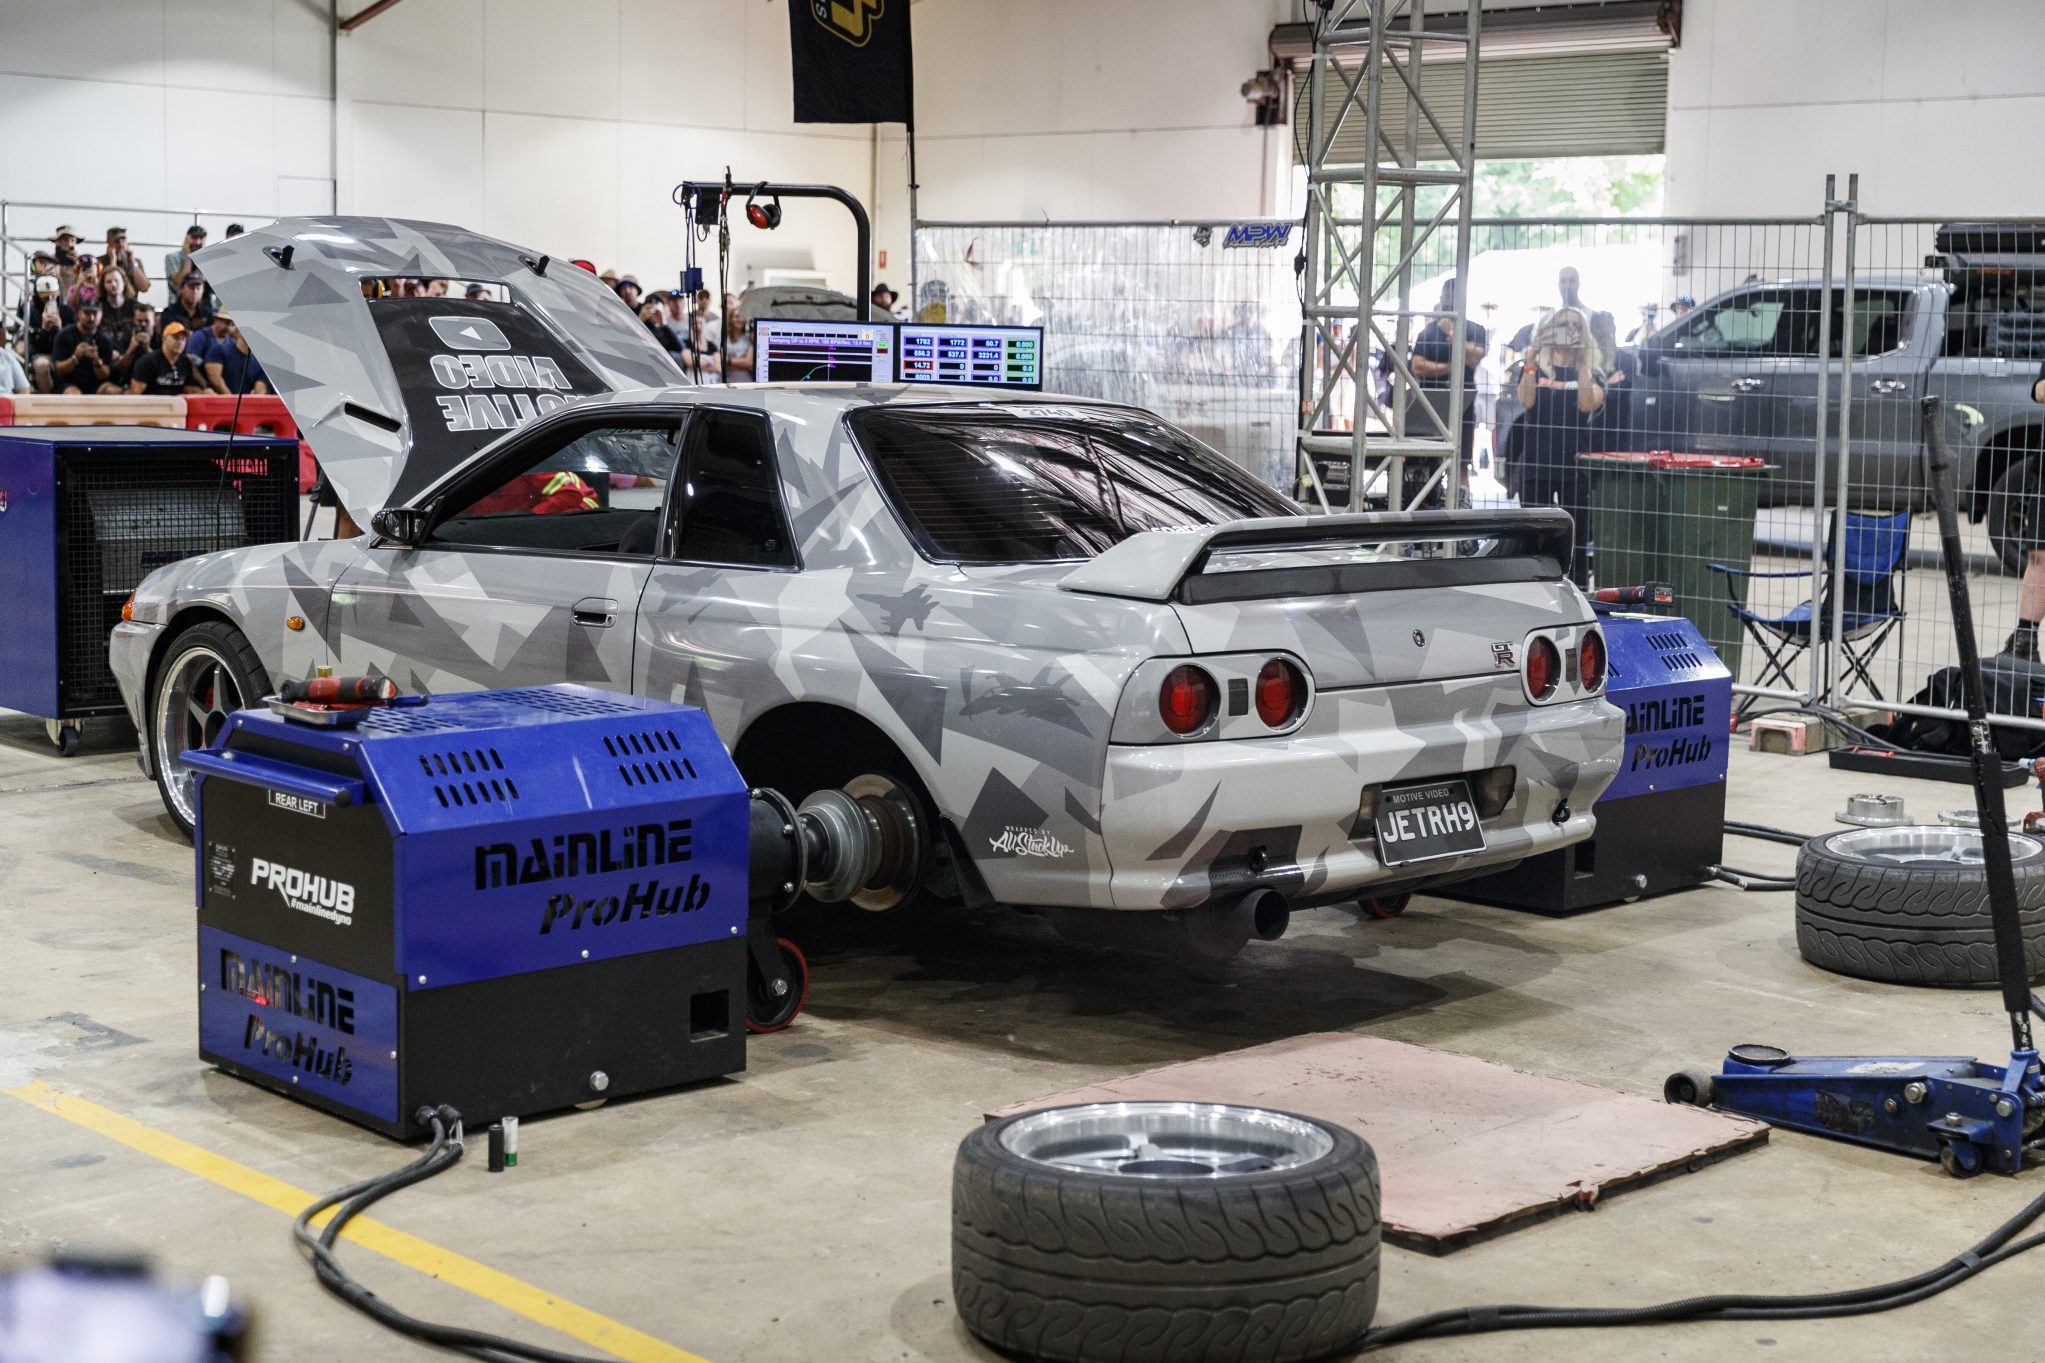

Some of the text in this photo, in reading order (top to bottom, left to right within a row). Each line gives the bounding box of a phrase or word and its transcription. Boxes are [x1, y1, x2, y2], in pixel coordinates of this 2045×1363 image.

[949, 339, 965, 347] 1772
[429, 354, 573, 390] VIDEO
[913, 361, 931, 369] 14.72
[1618, 694, 1705, 735] AINLINE
[1631, 734, 1711, 772] ProHub
[275, 792, 319, 815] REAR LEFT
[1392, 787, 1450, 804] MOTIVE VIDEO
[1383, 801, 1475, 843] JETRH9
[251, 857, 356, 914] PROHUB
[290, 897, 353, 926] #mainlinedyno
[540, 873, 711, 936] ProHub
[244, 1014, 353, 1086] ProHub
